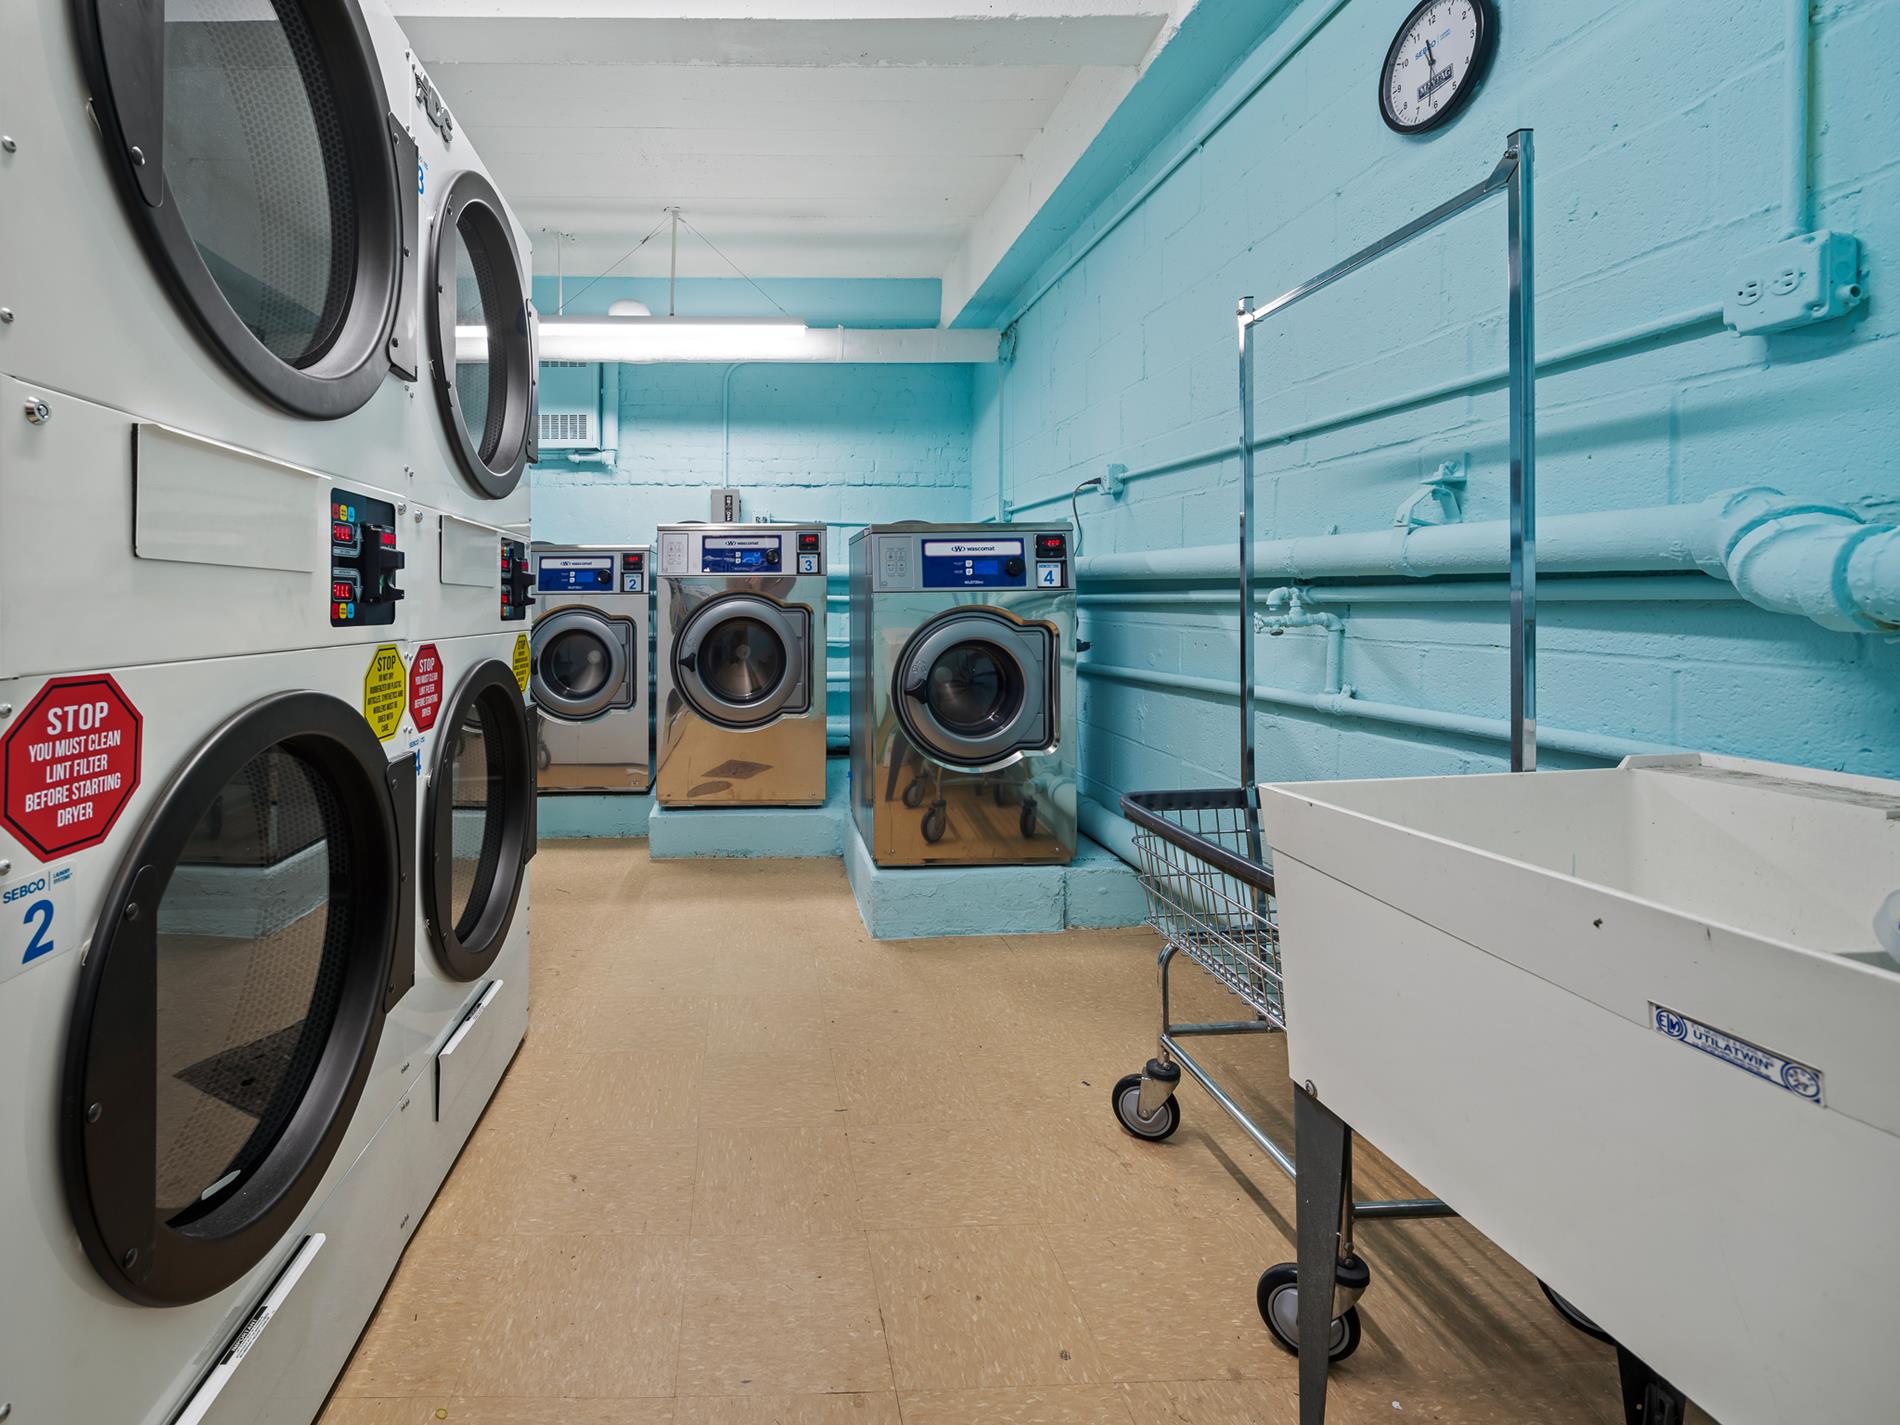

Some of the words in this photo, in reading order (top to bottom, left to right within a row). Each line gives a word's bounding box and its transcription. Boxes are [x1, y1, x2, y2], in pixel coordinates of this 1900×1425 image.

[1428, 15, 1436, 26] 12
[1462, 11, 1467, 20] 2
[1413, 33, 1420, 44] 11
[1470, 29, 1475, 38] 3
[1415, 39, 1437, 60] SEBO
[1401, 58, 1409, 69] 10
[1396, 84, 1402, 93] 9
[1452, 81, 1457, 90] 5
[1403, 101, 1408, 110] 8
[1433, 100, 1438, 109] 6
[804, 560, 812, 572] 3
[628, 578, 637, 590] 2
[1043, 570, 1054, 585] 4
[377, 655, 396, 672] STOP
[419, 657, 435, 672] STOP
[47, 701, 109, 735] STOP
[29, 742, 52, 763] YOU
[55, 735, 87, 758] MUST
[88, 729, 121, 752] CLEAN
[46, 761, 72, 784] LINT
[74, 754, 108, 777] FILTER
[25, 785, 70, 813] BEFORE
[71, 772, 121, 800] STARTING
[57, 801, 93, 827] DRYER
[2, 878, 46, 904] SEBCO
[21, 899, 54, 965] 2
[1693, 1029, 1770, 1070] UTILATWIN
[231, 1319, 257, 1351] IMPORTANT
